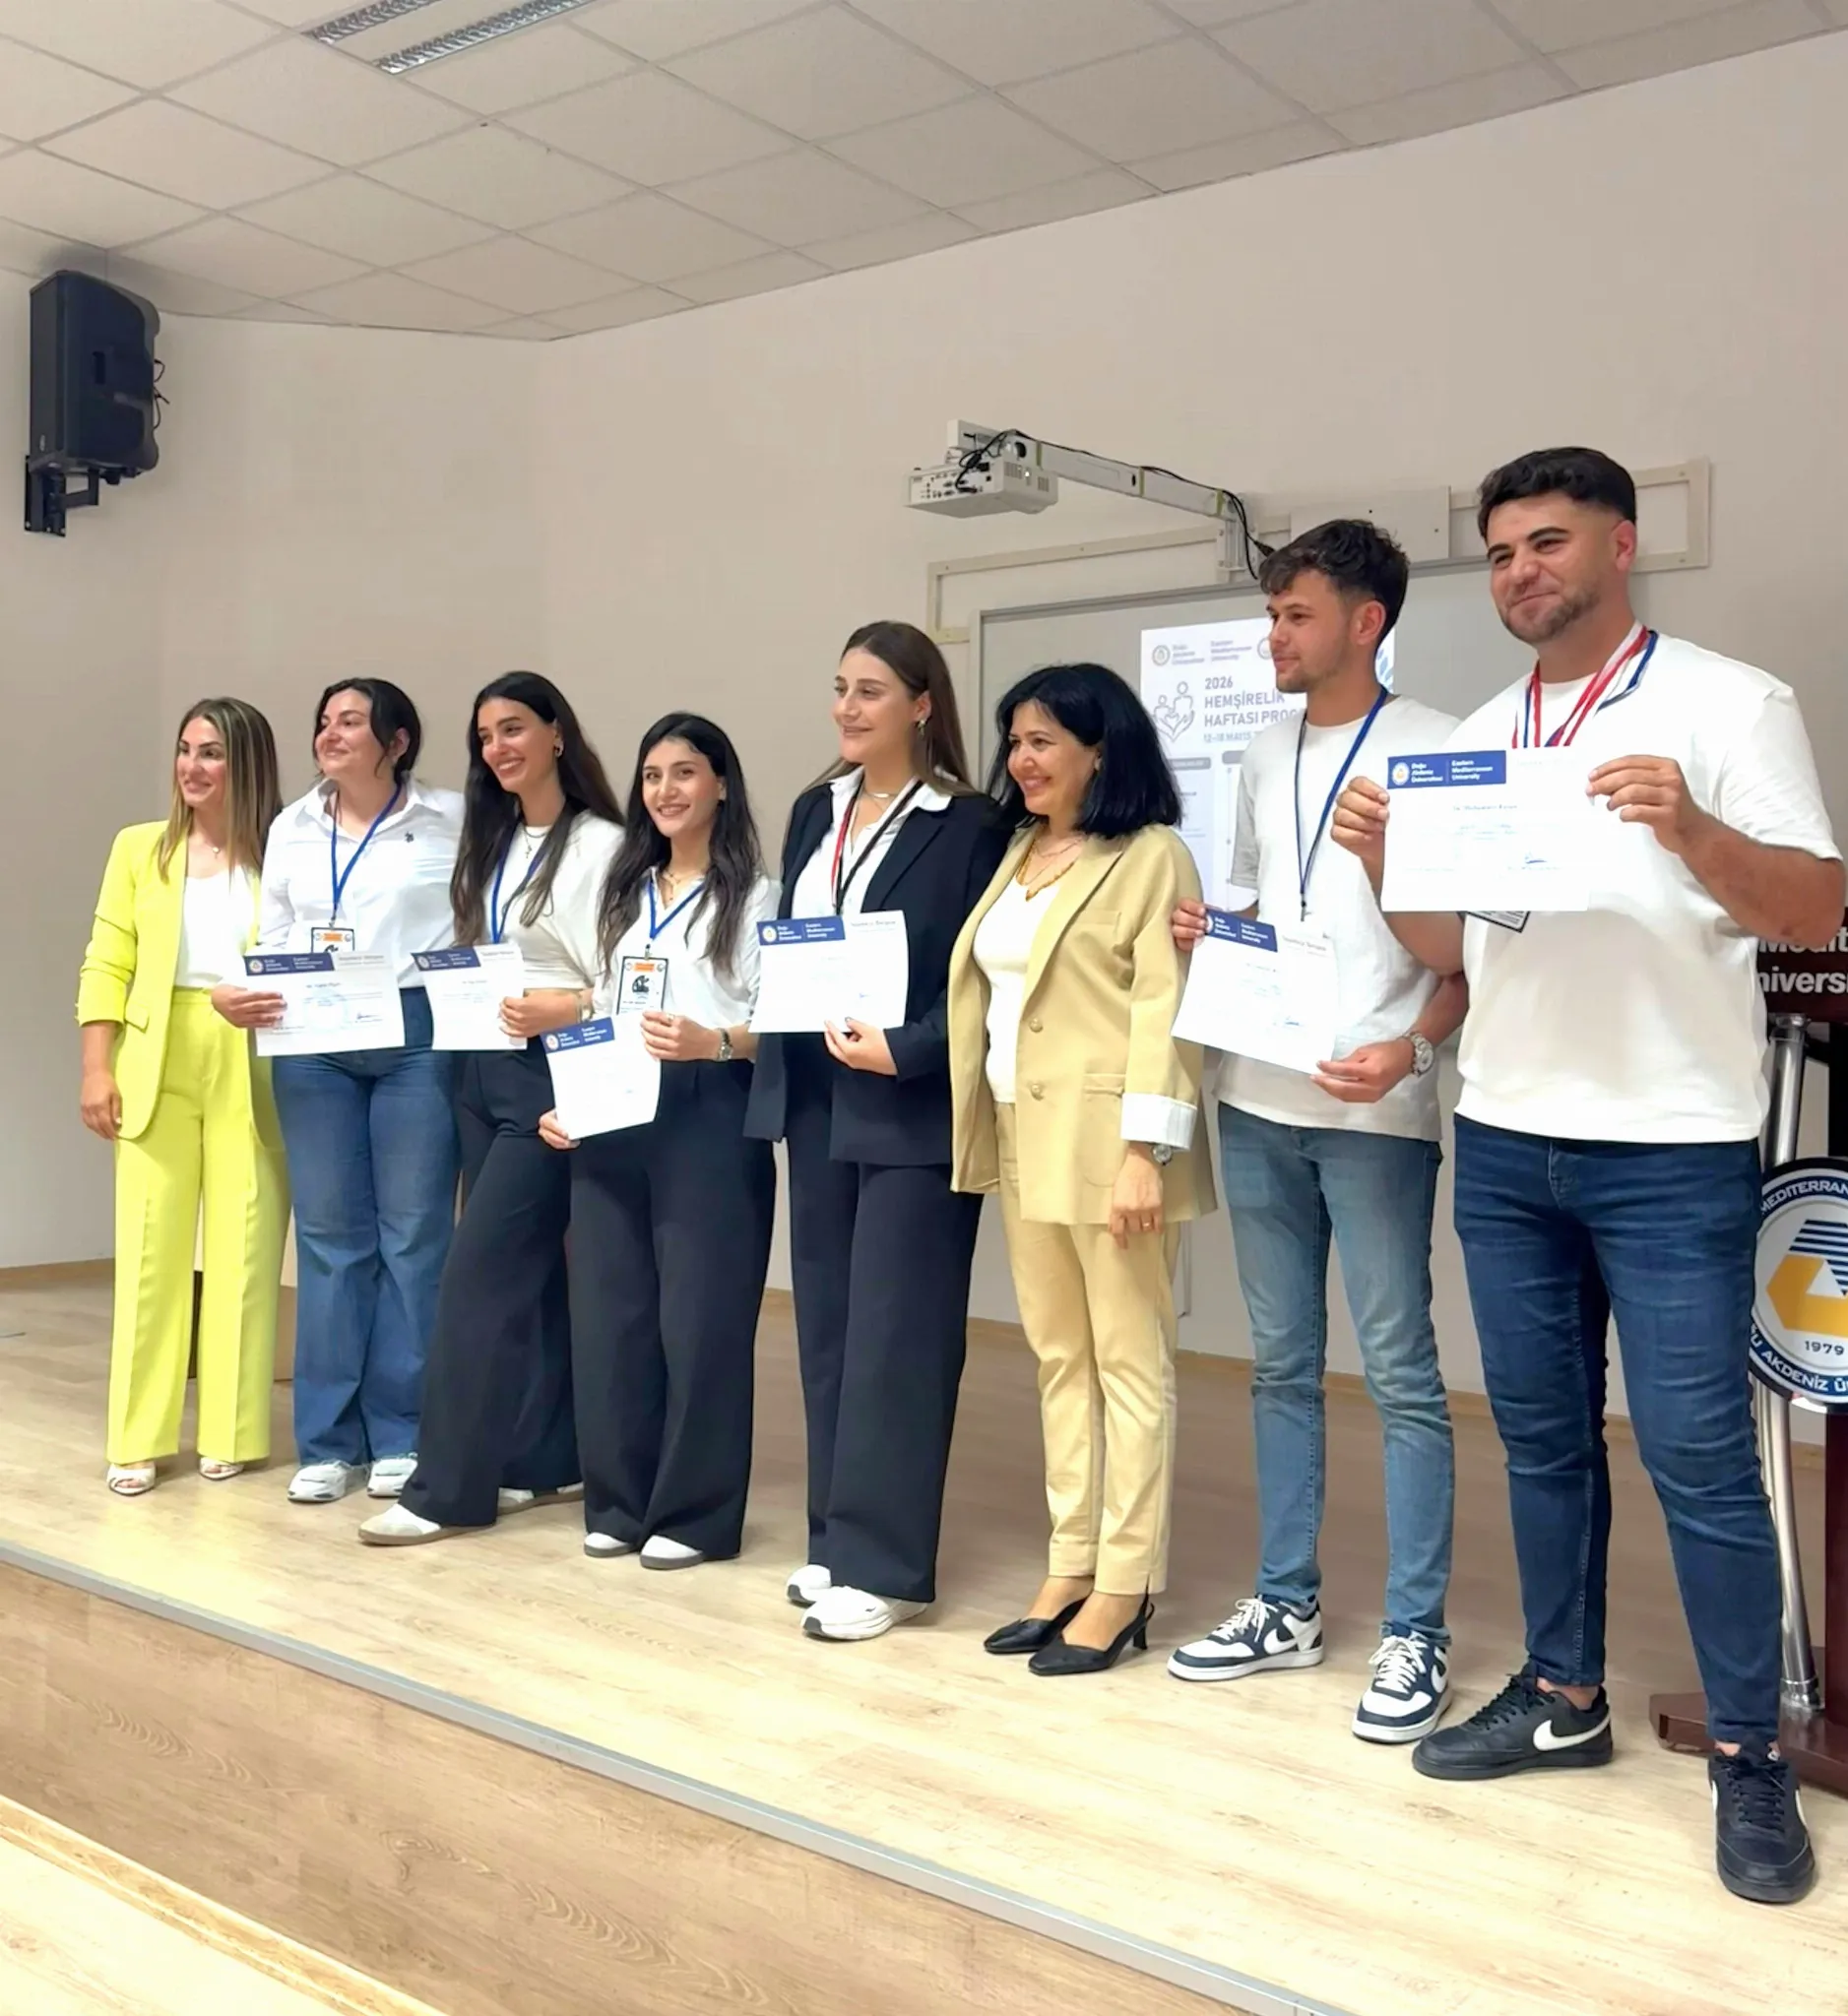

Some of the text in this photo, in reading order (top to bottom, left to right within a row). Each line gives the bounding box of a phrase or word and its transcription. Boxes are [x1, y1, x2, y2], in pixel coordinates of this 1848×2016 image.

[1204, 675, 1234, 690] 2026
[1204, 689, 1286, 710] HEMŞİRELİK
[1203, 711, 1259, 727] HAFTASI
[1758, 966, 1848, 994] nivers
[1805, 1340, 1844, 1355] 1979
[1760, 1350, 1829, 1392] AKDENİZ
[1833, 1376, 1848, 1392] Ü
